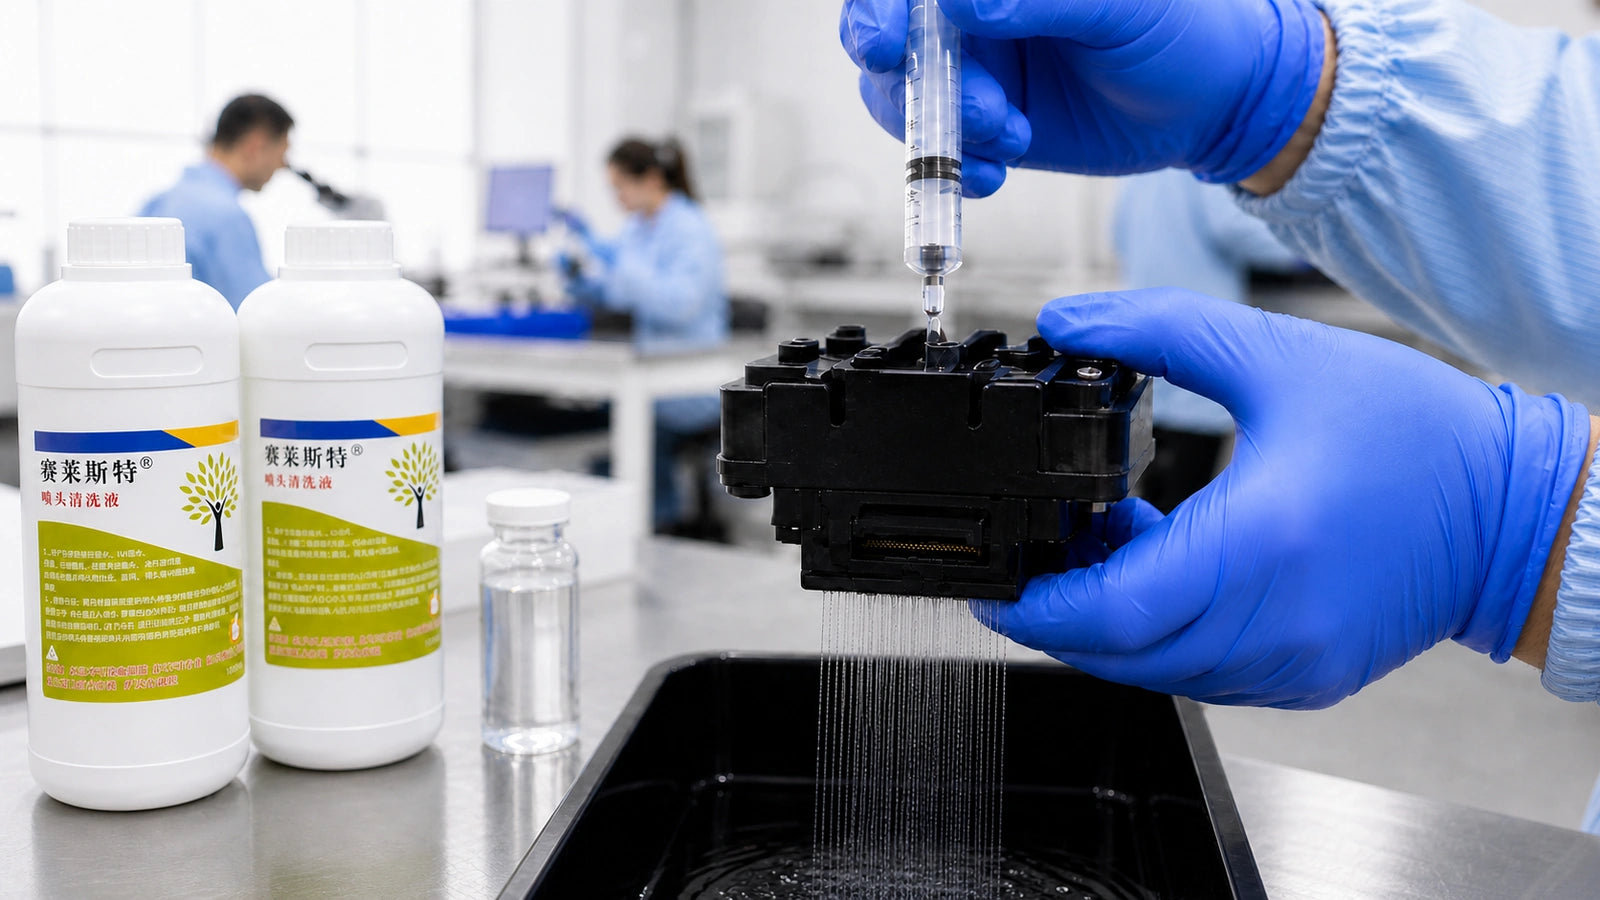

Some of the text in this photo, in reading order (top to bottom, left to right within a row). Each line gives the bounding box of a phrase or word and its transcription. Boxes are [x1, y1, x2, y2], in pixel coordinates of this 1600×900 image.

[264, 472, 333, 490] 喷头清洗液
[41, 490, 120, 508] 喷头清洗液
